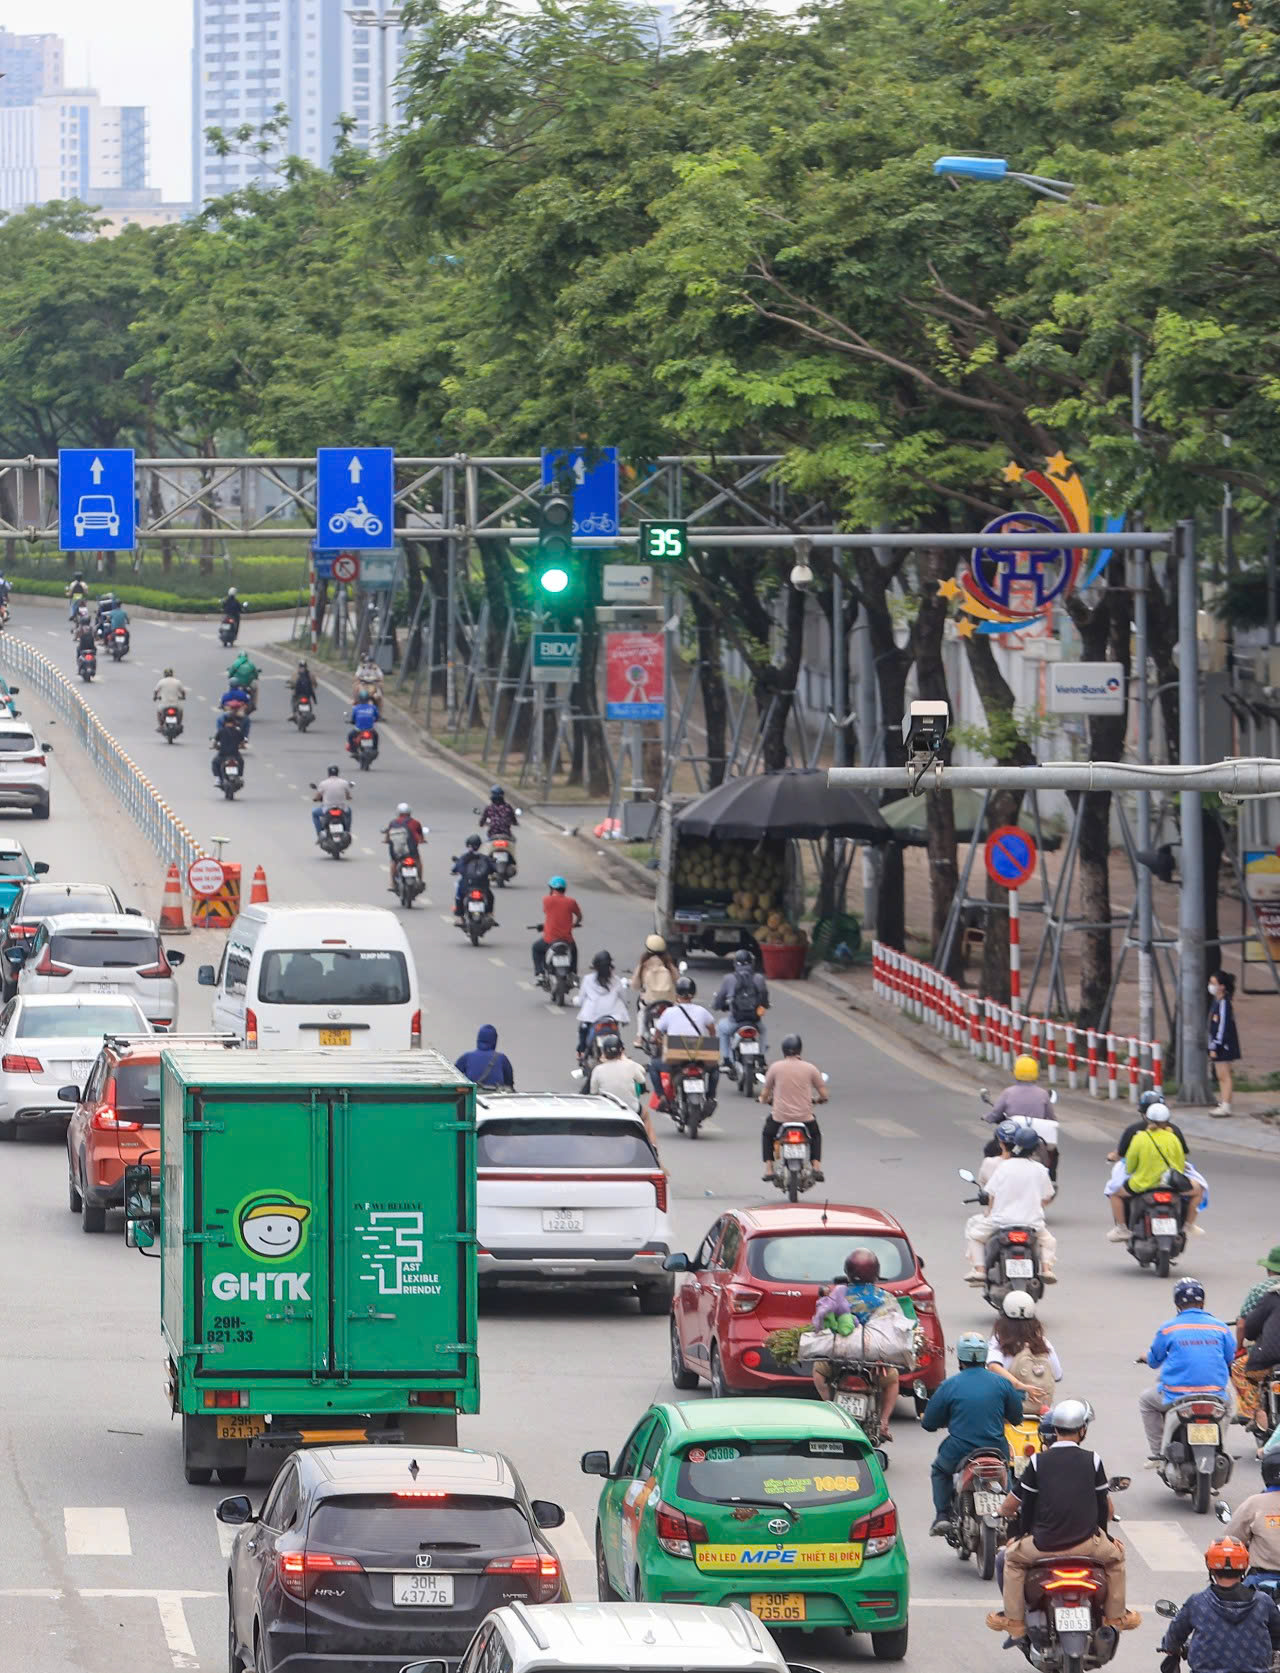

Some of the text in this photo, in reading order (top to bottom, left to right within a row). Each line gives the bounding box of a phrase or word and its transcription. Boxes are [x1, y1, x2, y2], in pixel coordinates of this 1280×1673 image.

[650, 529, 682, 556] 35
[540, 642, 576, 656] BIDV
[365, 1202, 370, 1210] F
[371, 1202, 386, 1210] WE
[388, 1202, 423, 1210] BELIEVE
[548, 1221, 581, 1230] 122.02
[403, 1263, 420, 1272] AST
[403, 1274, 439, 1283] LEXIBLE
[211, 1272, 312, 1301] GHTK
[403, 1285, 442, 1294] RIENDLY
[207, 1330, 254, 1343] 821.33
[231, 1416, 252, 1426] 29H
[222, 1427, 260, 1438] 821.33
[720, 1553, 737, 1562] LED
[740, 1550, 798, 1564] MPE
[411, 1577, 437, 1589] 30H
[315, 1588, 346, 1597] HR-V
[401, 1590, 447, 1603] 437.76
[767, 1594, 789, 1606] 30F
[757, 1607, 800, 1619] 735.05
